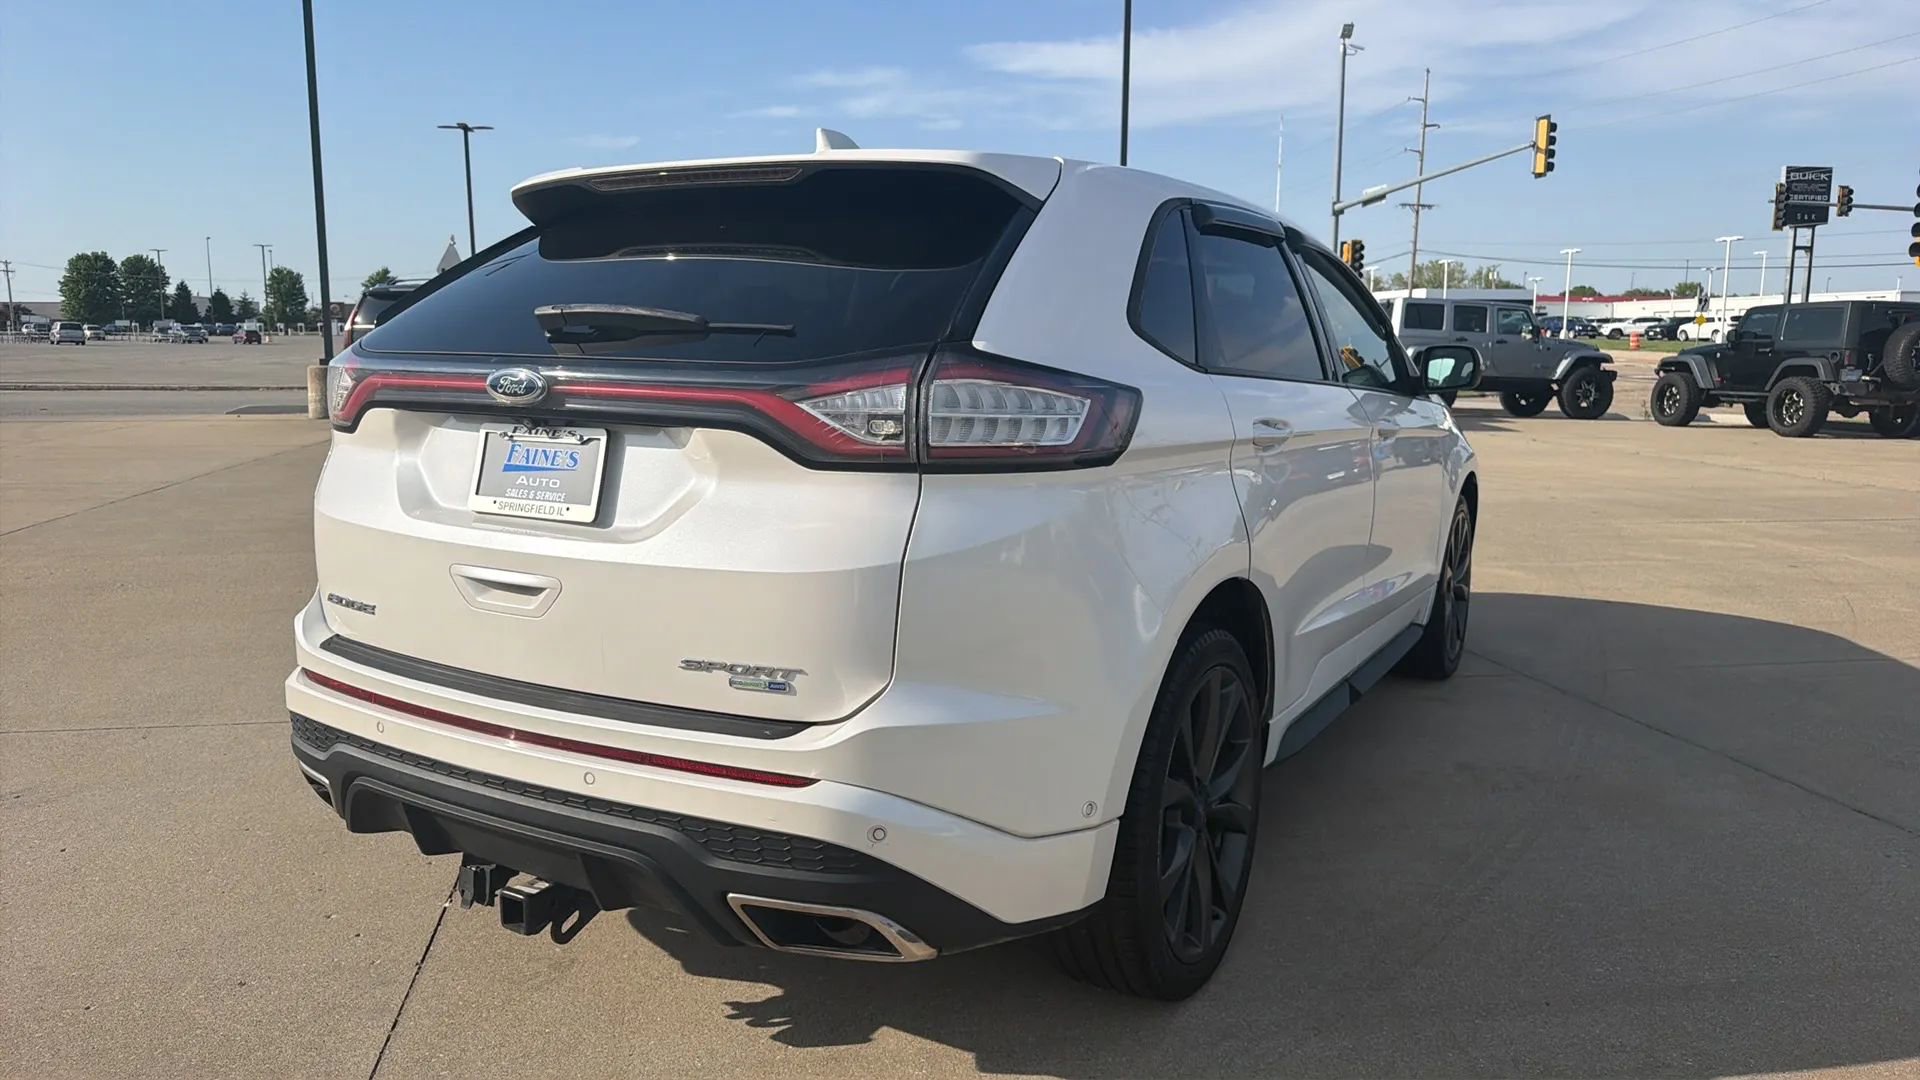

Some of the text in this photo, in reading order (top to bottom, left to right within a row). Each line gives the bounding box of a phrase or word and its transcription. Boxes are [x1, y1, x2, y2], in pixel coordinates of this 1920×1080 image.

[1790, 172, 1829, 181] BUICK
[1791, 183, 1828, 192] GMC
[496, 376, 527, 394] Ford
[505, 443, 580, 469] FAINE'S
[515, 475, 561, 488] AUTO
[504, 487, 529, 499] SALES
[535, 490, 567, 502] SERVICE
[497, 500, 565, 517] SPRINGFIELD IL
[327, 592, 377, 616] EDGE
[679, 659, 809, 682] SPORT
